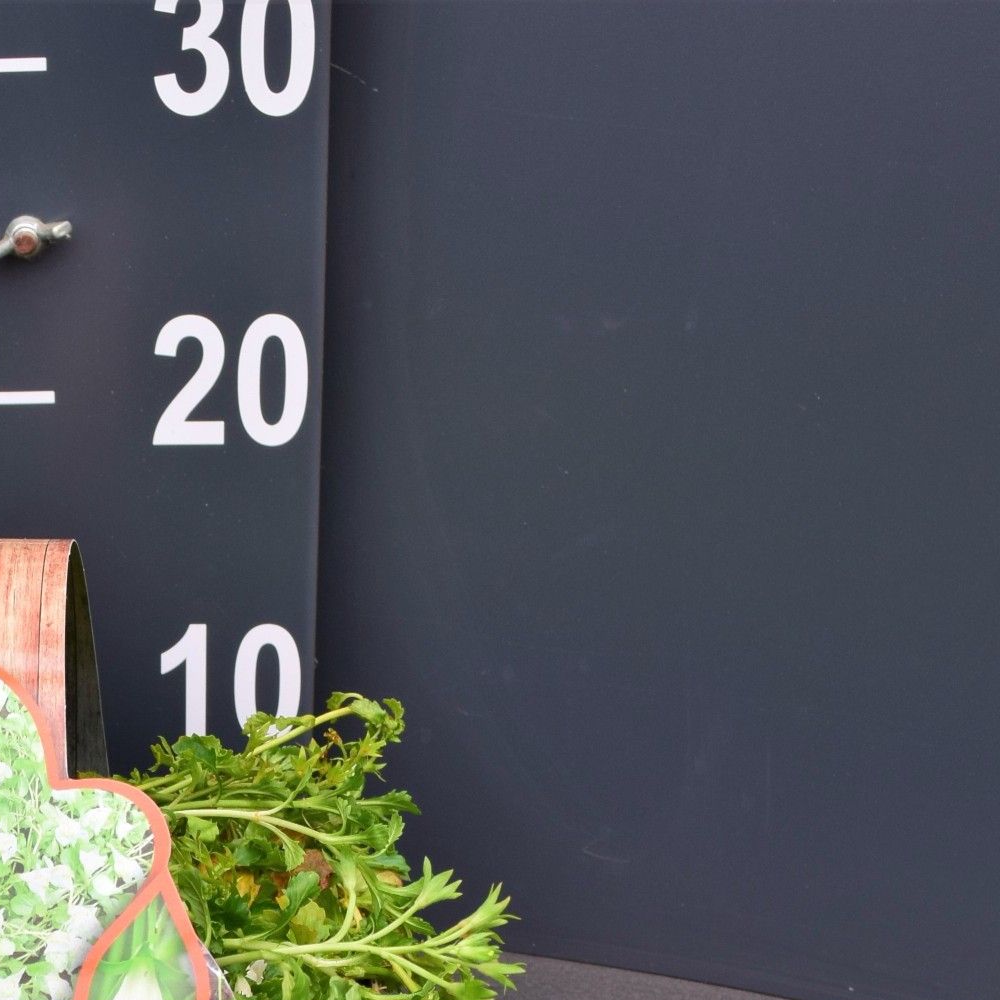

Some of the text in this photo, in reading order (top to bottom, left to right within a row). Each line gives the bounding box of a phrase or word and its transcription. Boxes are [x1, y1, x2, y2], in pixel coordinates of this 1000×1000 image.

[153, 0, 315, 117] 30
[152, 313, 309, 447] 20
[160, 623, 301, 738] 10
